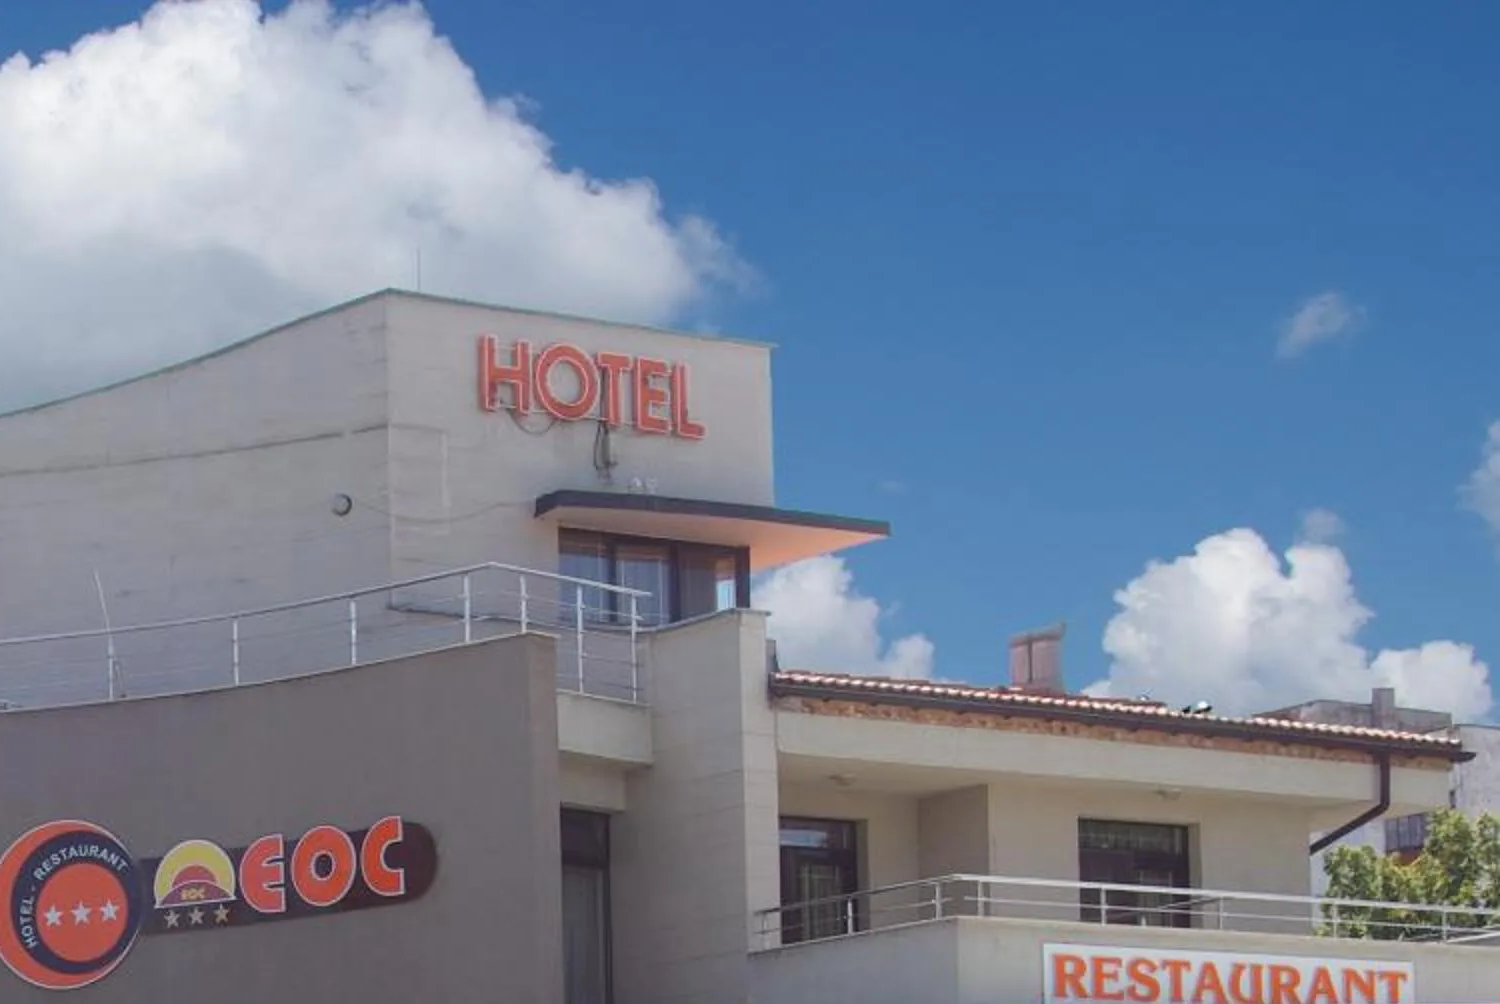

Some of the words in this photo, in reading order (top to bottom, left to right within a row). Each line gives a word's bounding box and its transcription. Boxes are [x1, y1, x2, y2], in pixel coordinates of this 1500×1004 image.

[477, 332, 707, 440] HOTEL
[19, 896, 38, 949] HOTEL
[33, 844, 129, 881] RESTAURANT
